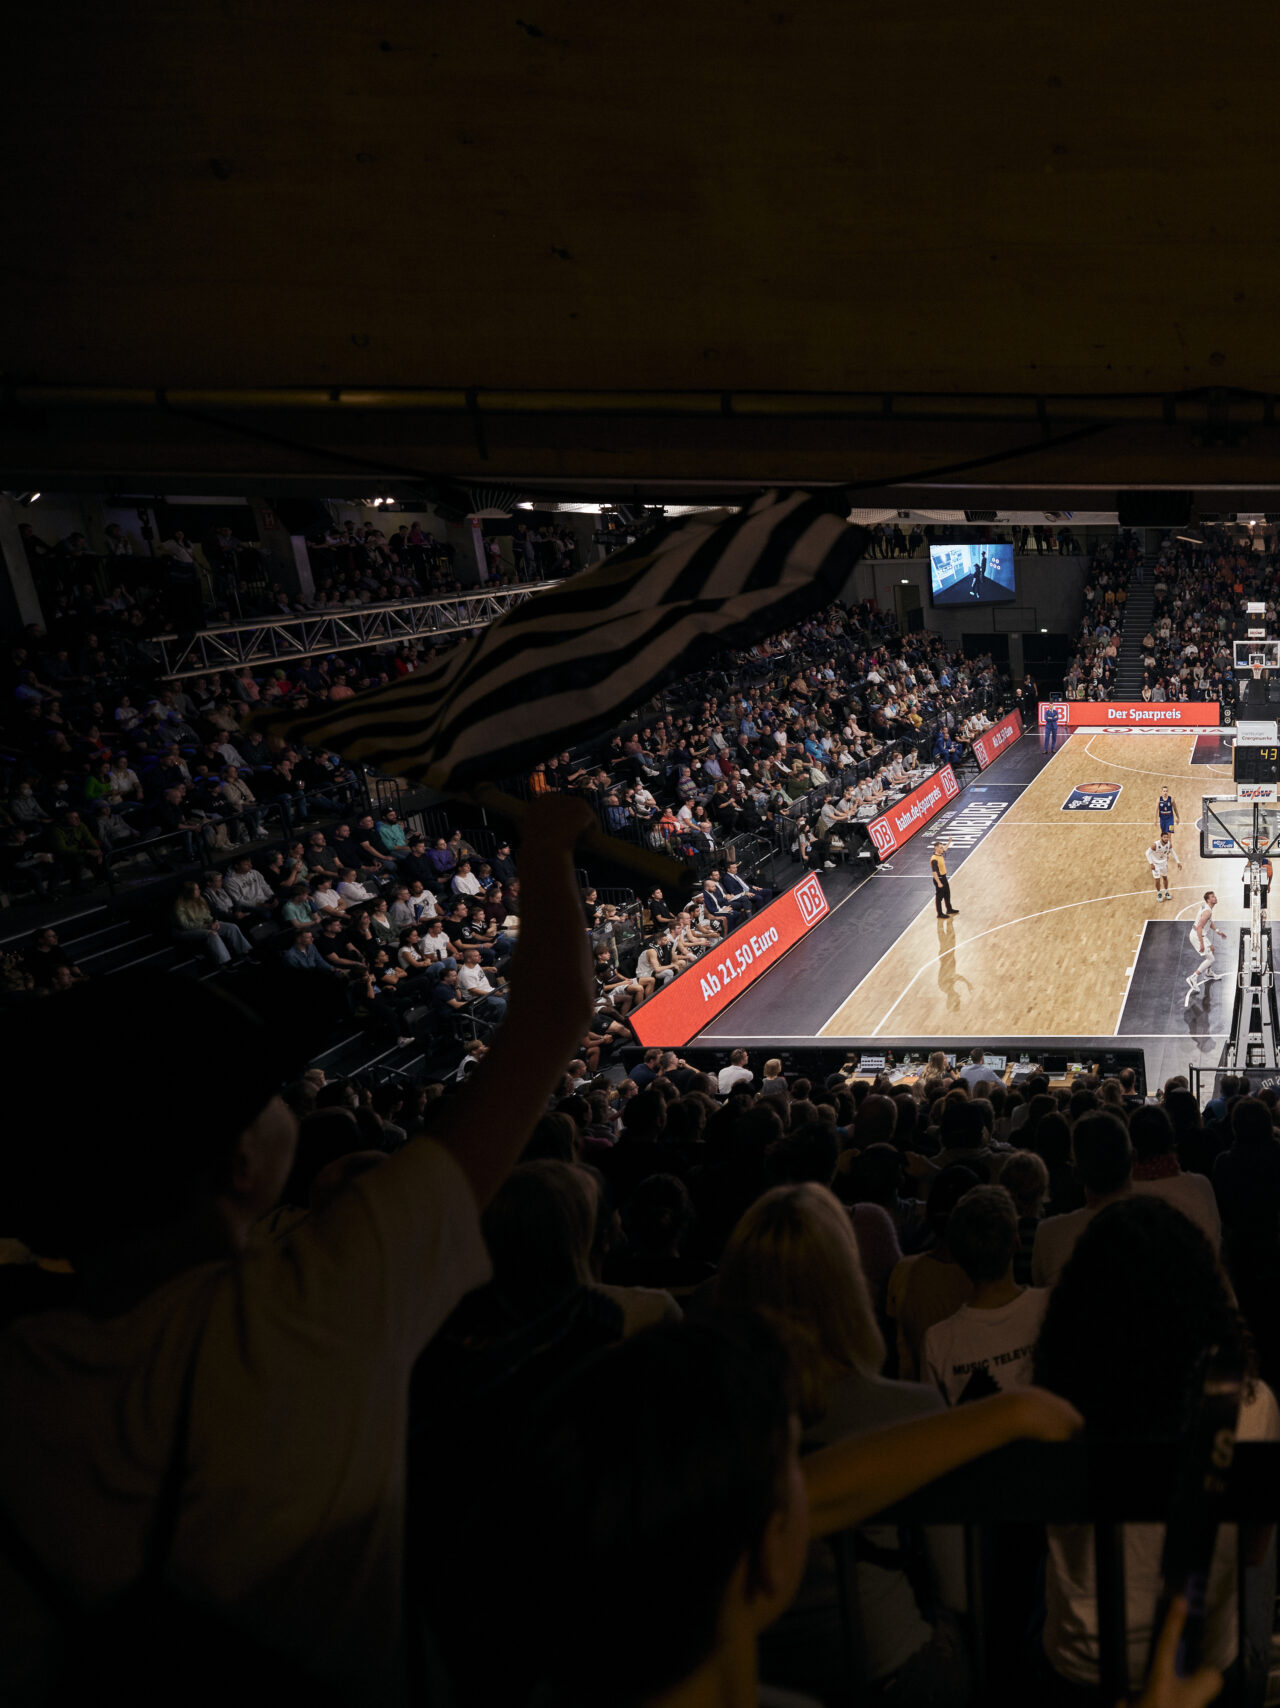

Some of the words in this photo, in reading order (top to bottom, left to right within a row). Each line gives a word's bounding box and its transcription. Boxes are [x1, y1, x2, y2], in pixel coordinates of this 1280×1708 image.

[1108, 709, 1127, 719] Der
[1129, 709, 1181, 721] Sparpreis
[1260, 748, 1278, 761] 43
[895, 785, 942, 832] bahn.de/sparpreis
[1089, 795, 1113, 809] BBL
[873, 825, 892, 852] DB
[927, 801, 1009, 849] HAMBURG
[799, 883, 821, 917] DB
[700, 972, 721, 1002] Ab
[717, 944, 752, 985] 21,50
[749, 926, 779, 958] Euro
[953, 1360, 990, 1376] MUSIC
